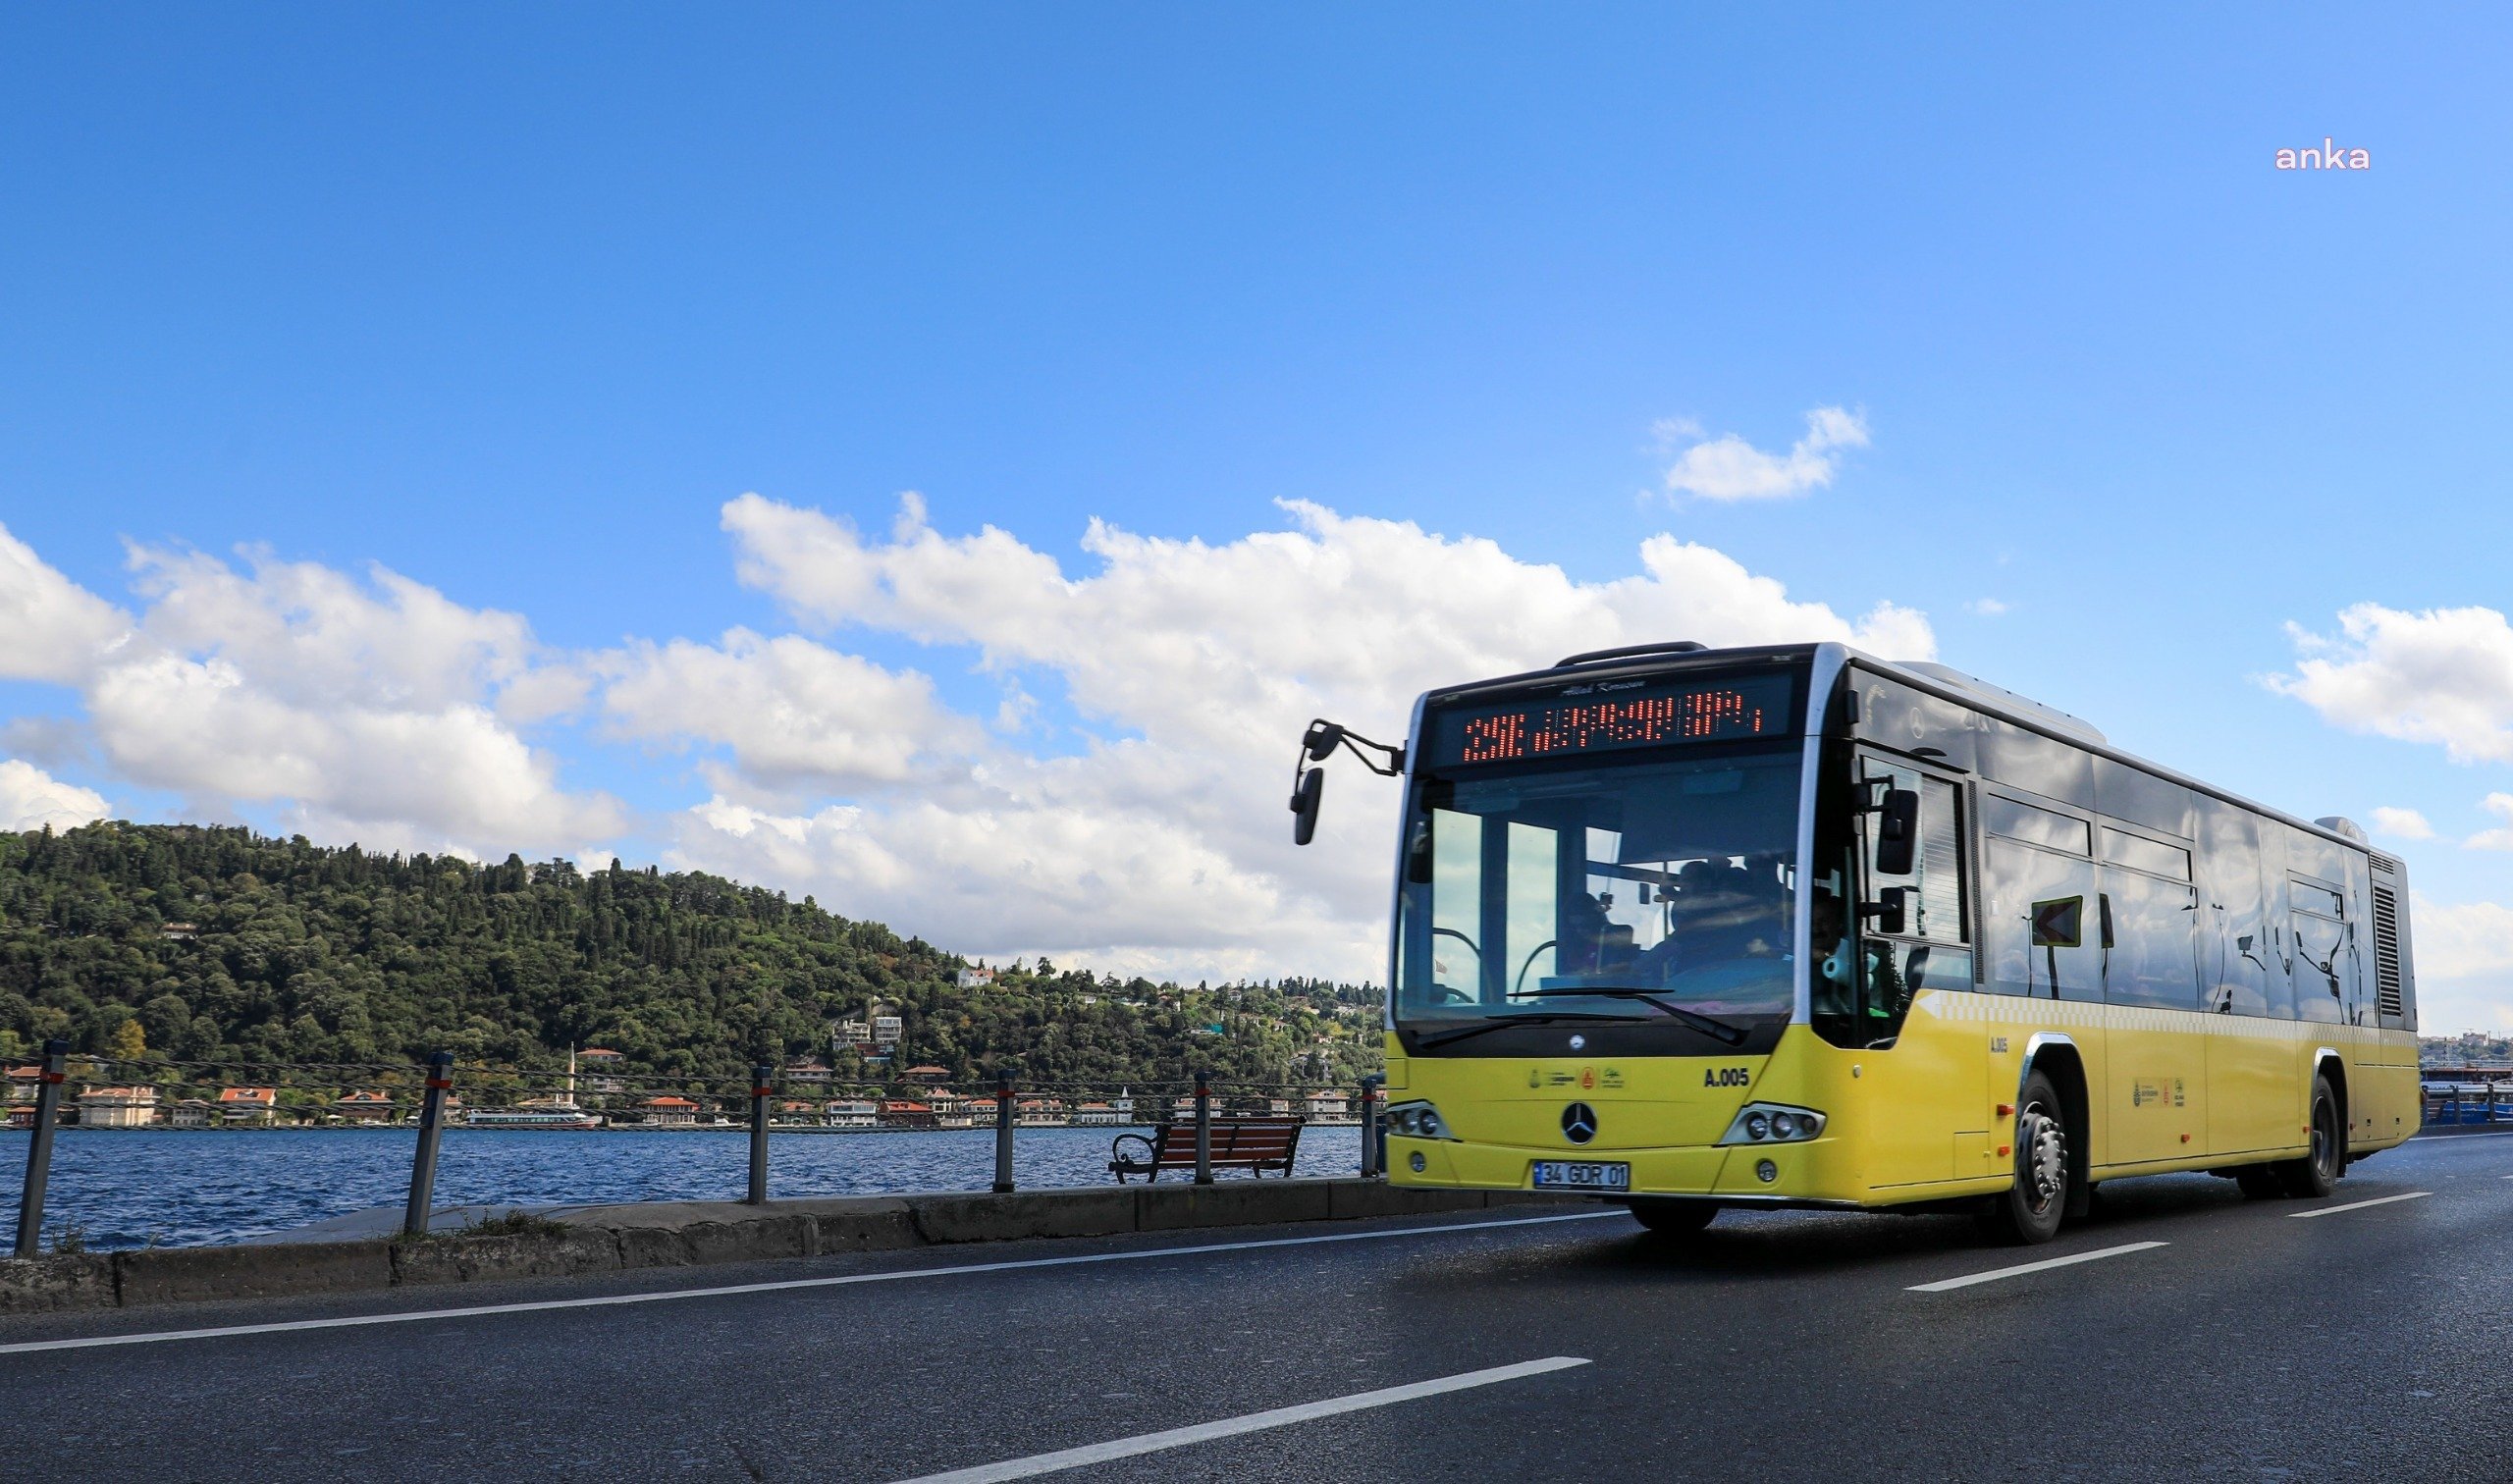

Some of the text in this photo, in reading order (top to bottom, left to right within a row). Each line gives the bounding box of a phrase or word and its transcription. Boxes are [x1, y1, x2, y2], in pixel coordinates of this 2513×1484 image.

[1704, 1067, 1749, 1086] A.005
[1543, 1164, 1626, 1185] 34 GDR 01
